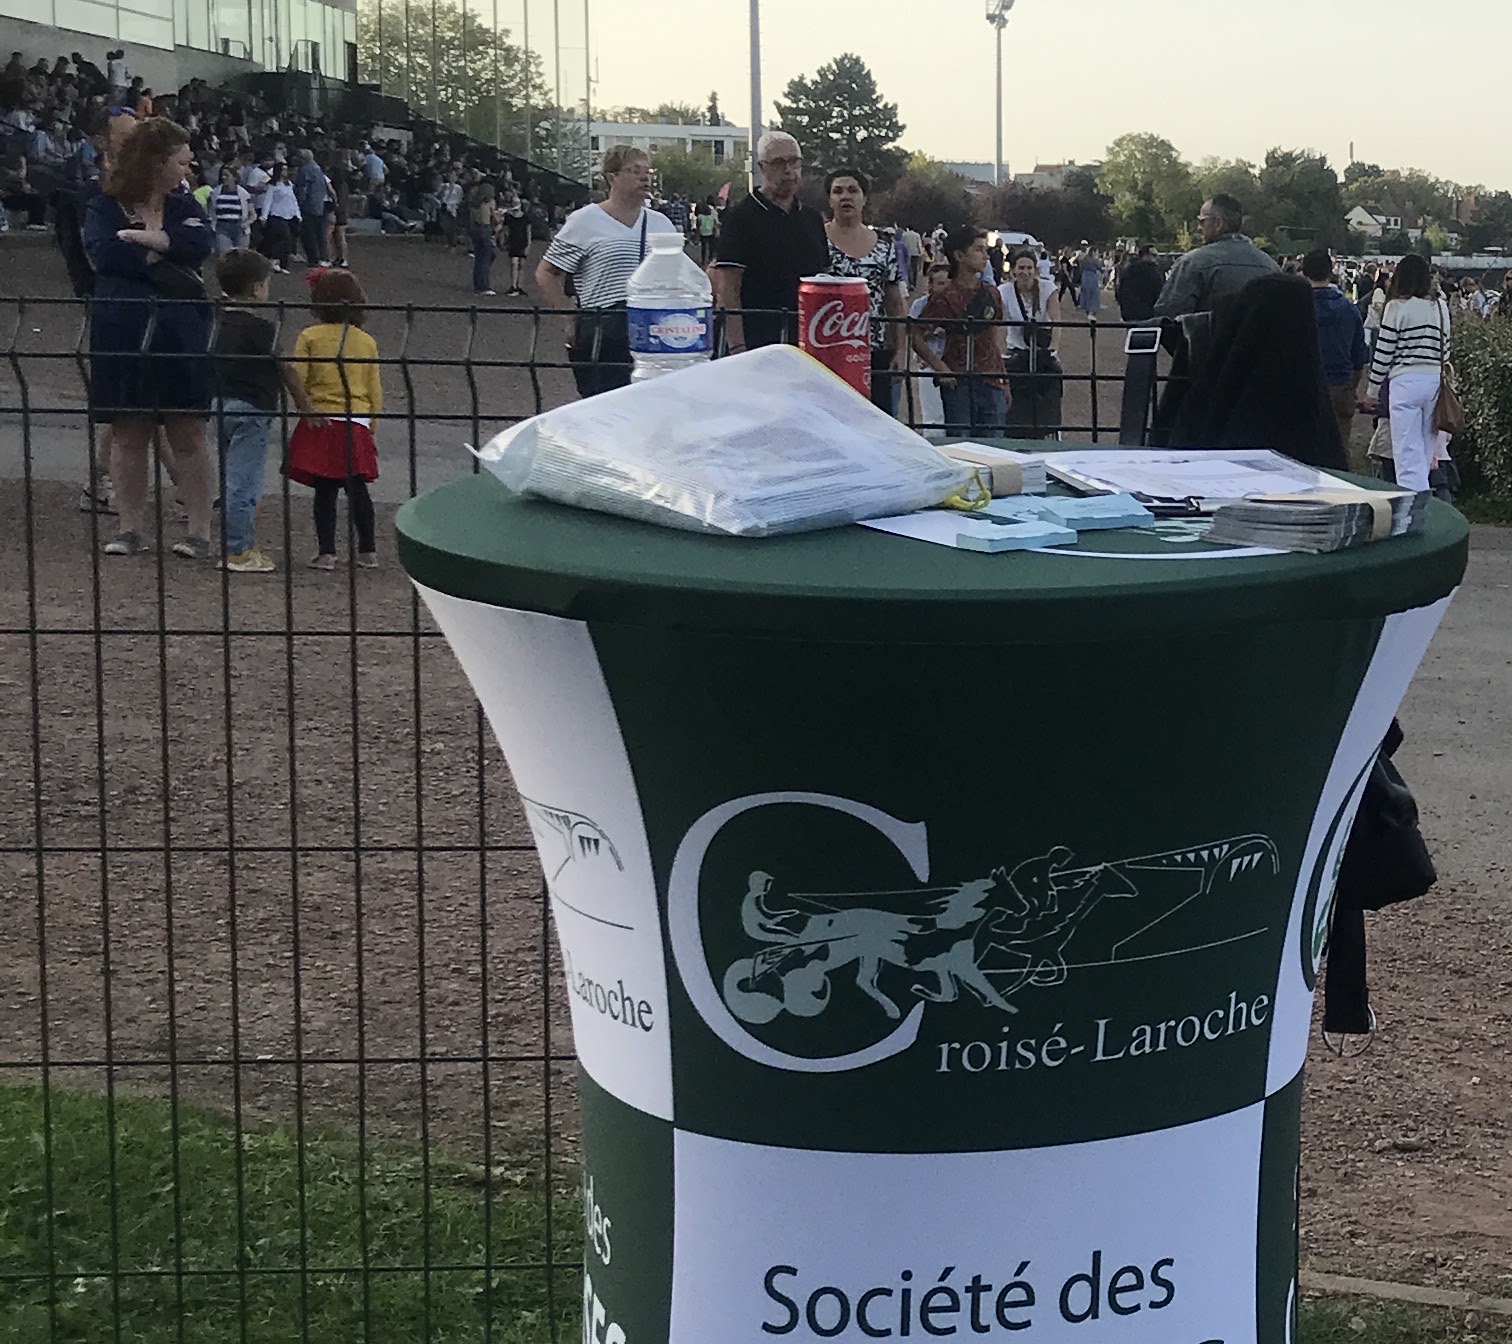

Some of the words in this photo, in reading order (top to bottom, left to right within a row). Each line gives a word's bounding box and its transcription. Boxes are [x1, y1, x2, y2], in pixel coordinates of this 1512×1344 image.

[808, 300, 870, 348] Coca
[761, 1260, 1036, 1339] Société
[1058, 1249, 1176, 1324] des
